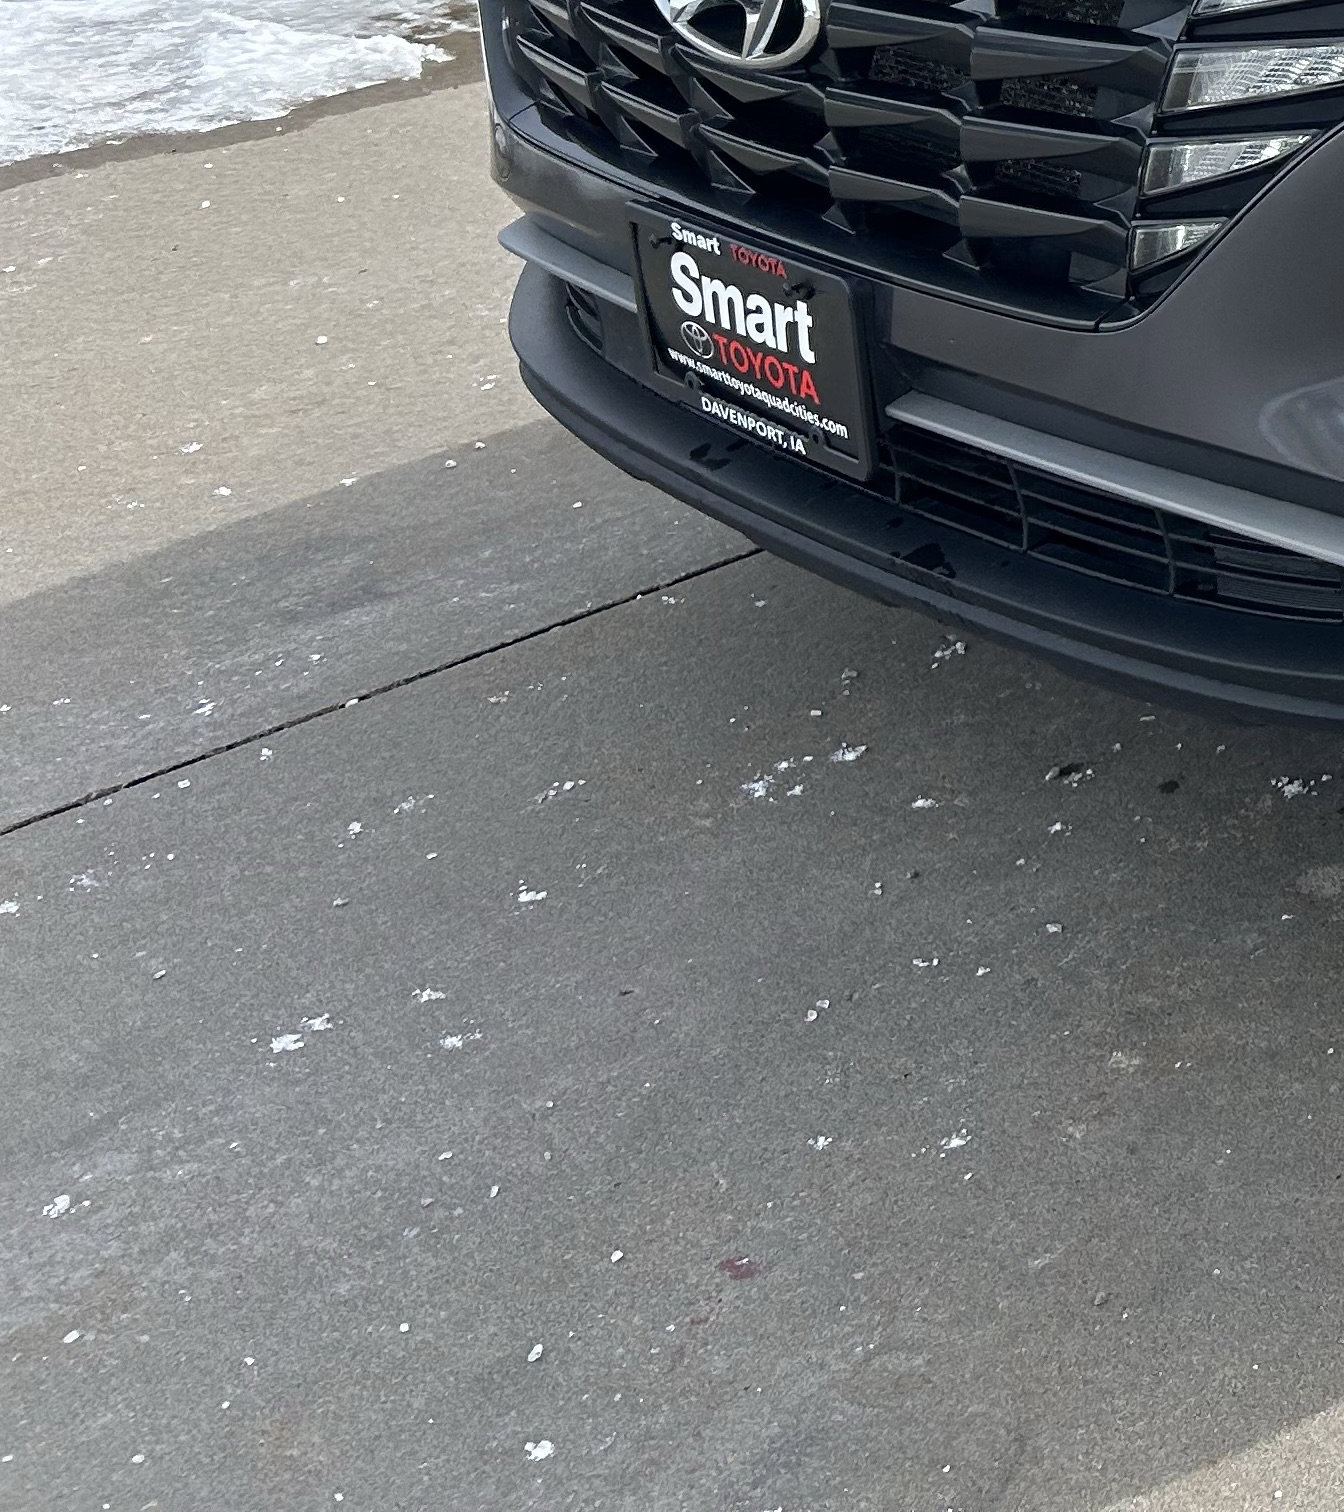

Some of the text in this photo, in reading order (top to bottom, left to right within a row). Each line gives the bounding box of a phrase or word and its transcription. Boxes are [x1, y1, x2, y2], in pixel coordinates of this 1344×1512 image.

[670, 221, 788, 279] Smart TOYOTA
[670, 251, 816, 365] Smart
[667, 347, 849, 439] www.smarttoyotaquadcities.com
[712, 333, 821, 405] TOYOTA
[701, 396, 807, 456] DAVENPORT, IA
